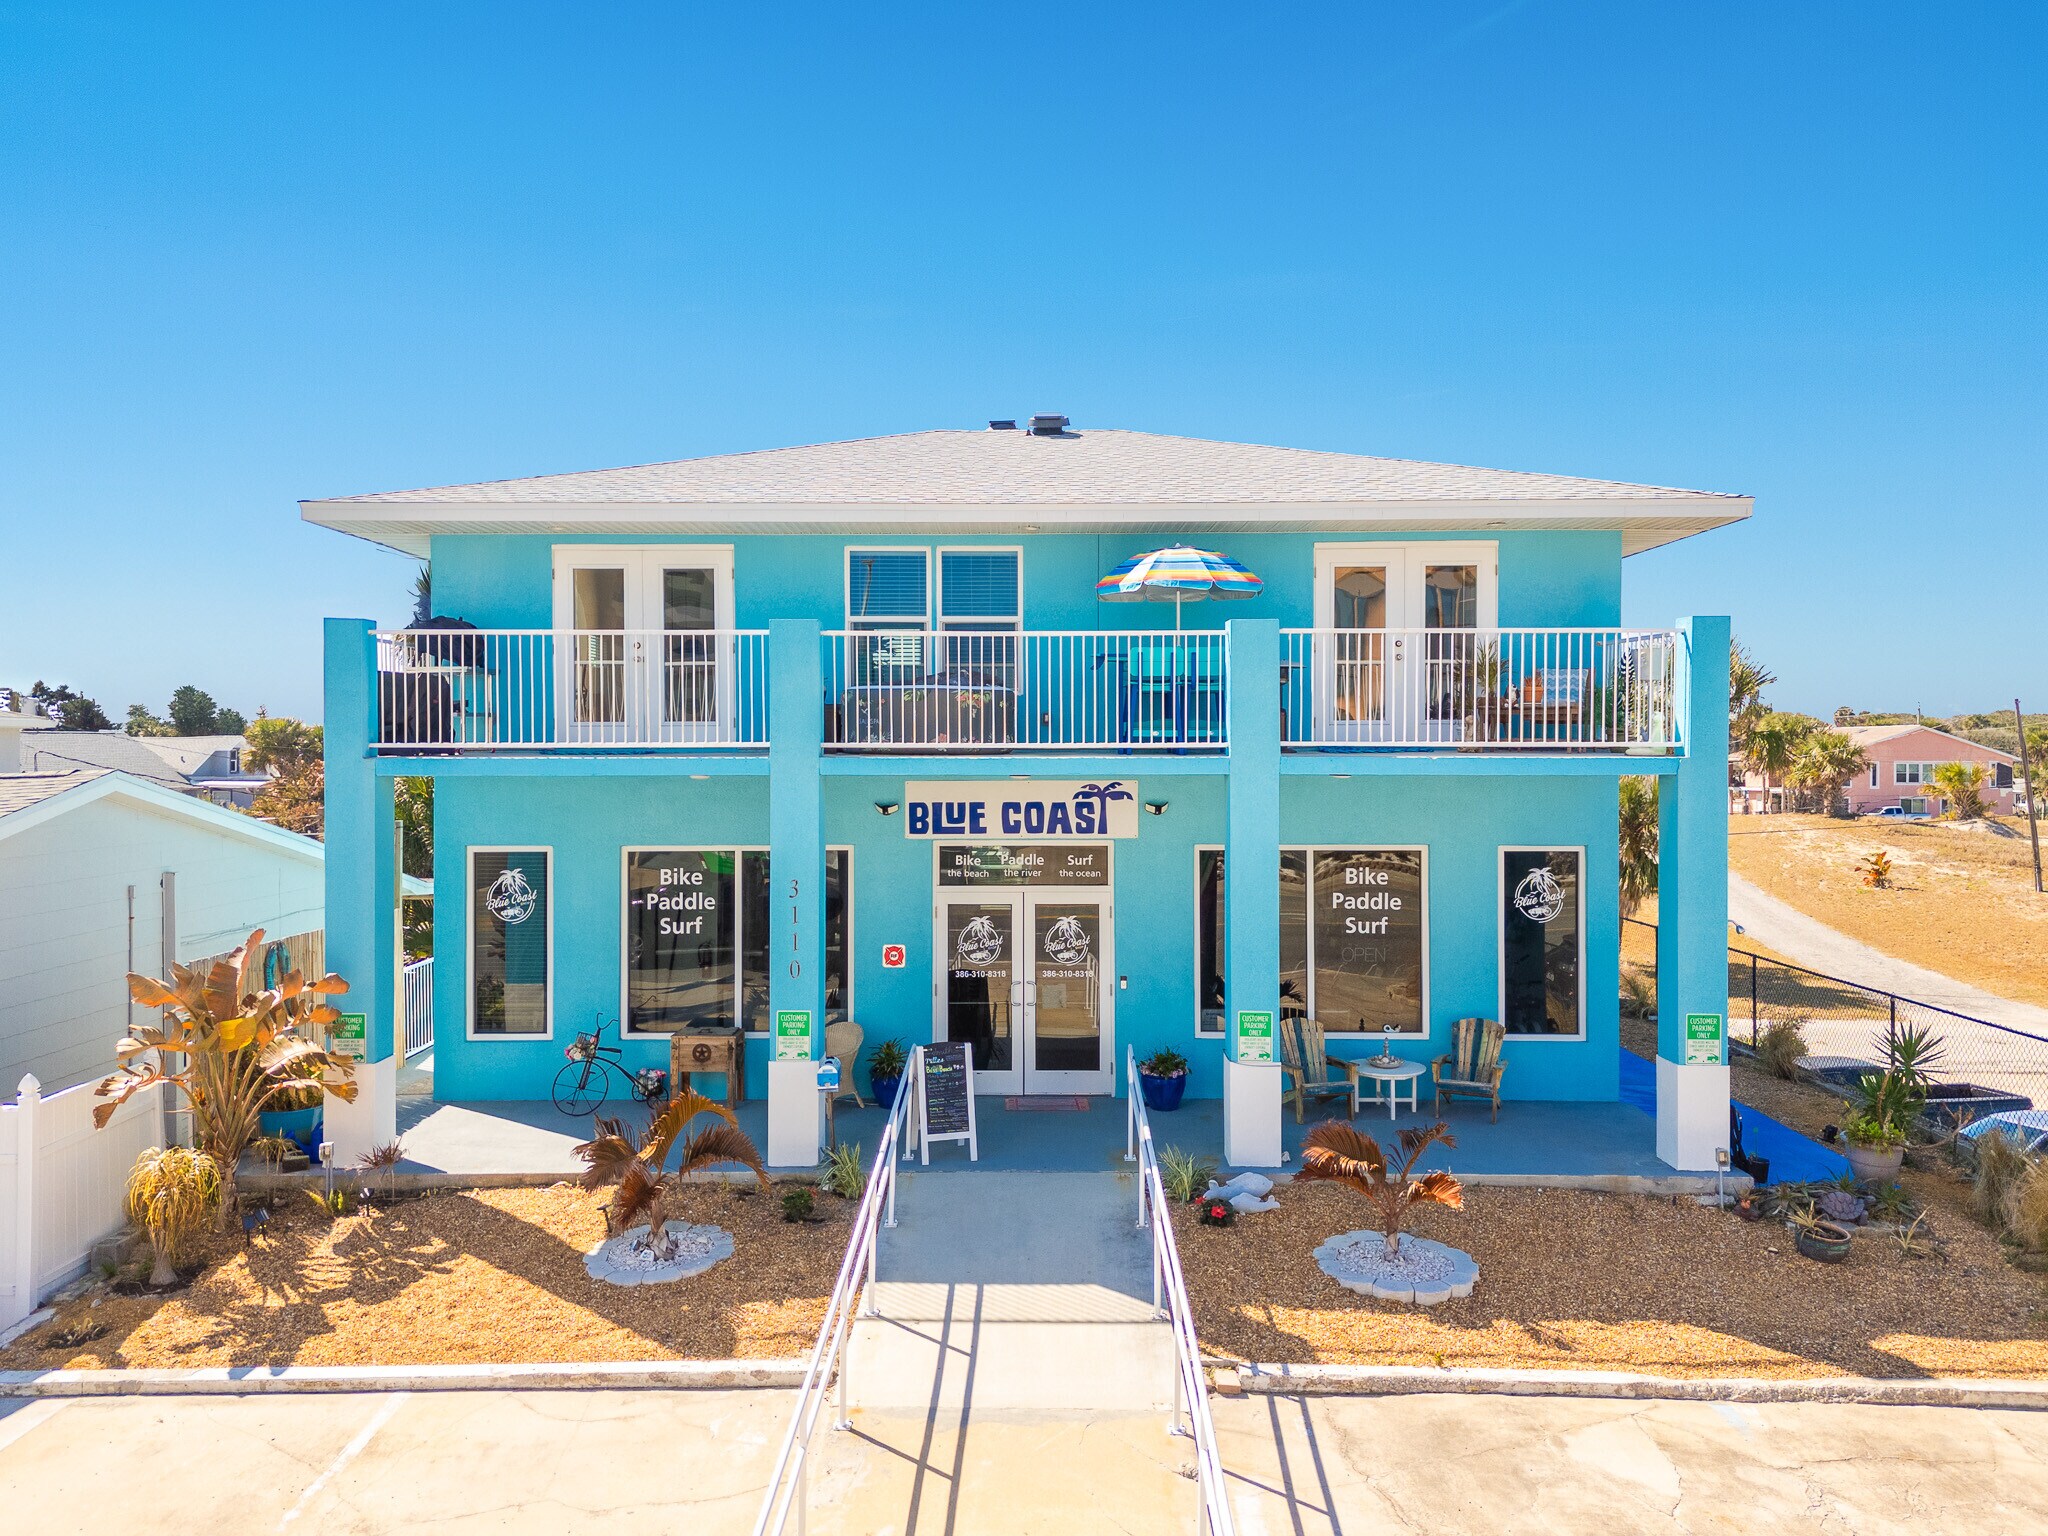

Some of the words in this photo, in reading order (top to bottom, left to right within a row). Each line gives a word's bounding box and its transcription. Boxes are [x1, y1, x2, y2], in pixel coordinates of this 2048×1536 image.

[908, 802, 987, 834] BLUE
[1002, 782, 1134, 834] COAST
[955, 854, 982, 866] Bike
[1000, 853, 1045, 866] Paddle
[1067, 854, 1094, 866] Surf
[660, 867, 703, 886] Bike
[947, 869, 962, 878] the
[964, 869, 990, 878] beach
[1003, 869, 1019, 877] the
[1021, 869, 1042, 877] river
[1058, 869, 1074, 878] the
[1075, 870, 1101, 878] ocean
[1345, 866, 1389, 886] Bike
[485, 896, 510, 910] Blue
[511, 889, 538, 904] Coast
[646, 892, 716, 910] Paddle
[1332, 891, 1402, 910] Paddle
[1513, 896, 1539, 908] Blue
[1539, 889, 1566, 903] Coast
[660, 916, 703, 935] Surf
[789, 879, 801, 979] 3110
[1345, 916, 1389, 935] Surf
[956, 940, 979, 953] Blue
[979, 935, 1004, 949] Coast
[1044, 940, 1066, 953] Blue
[1066, 935, 1091, 949] Coast
[1341, 946, 1386, 962] OPEN
[955, 970, 1007, 978] 386-310-8318
[1042, 970, 1095, 978] 386-310-8318
[780, 1014, 808, 1022] CUSTOMER
[1241, 1014, 1270, 1022] CUSTOMER
[1689, 1017, 1718, 1025] CUSTOMER
[782, 1021, 806, 1029] PARKING
[1691, 1024, 1716, 1032] PARKING
[786, 1028, 801, 1036] ONLY
[1696, 1031, 1711, 1039] ONLY
